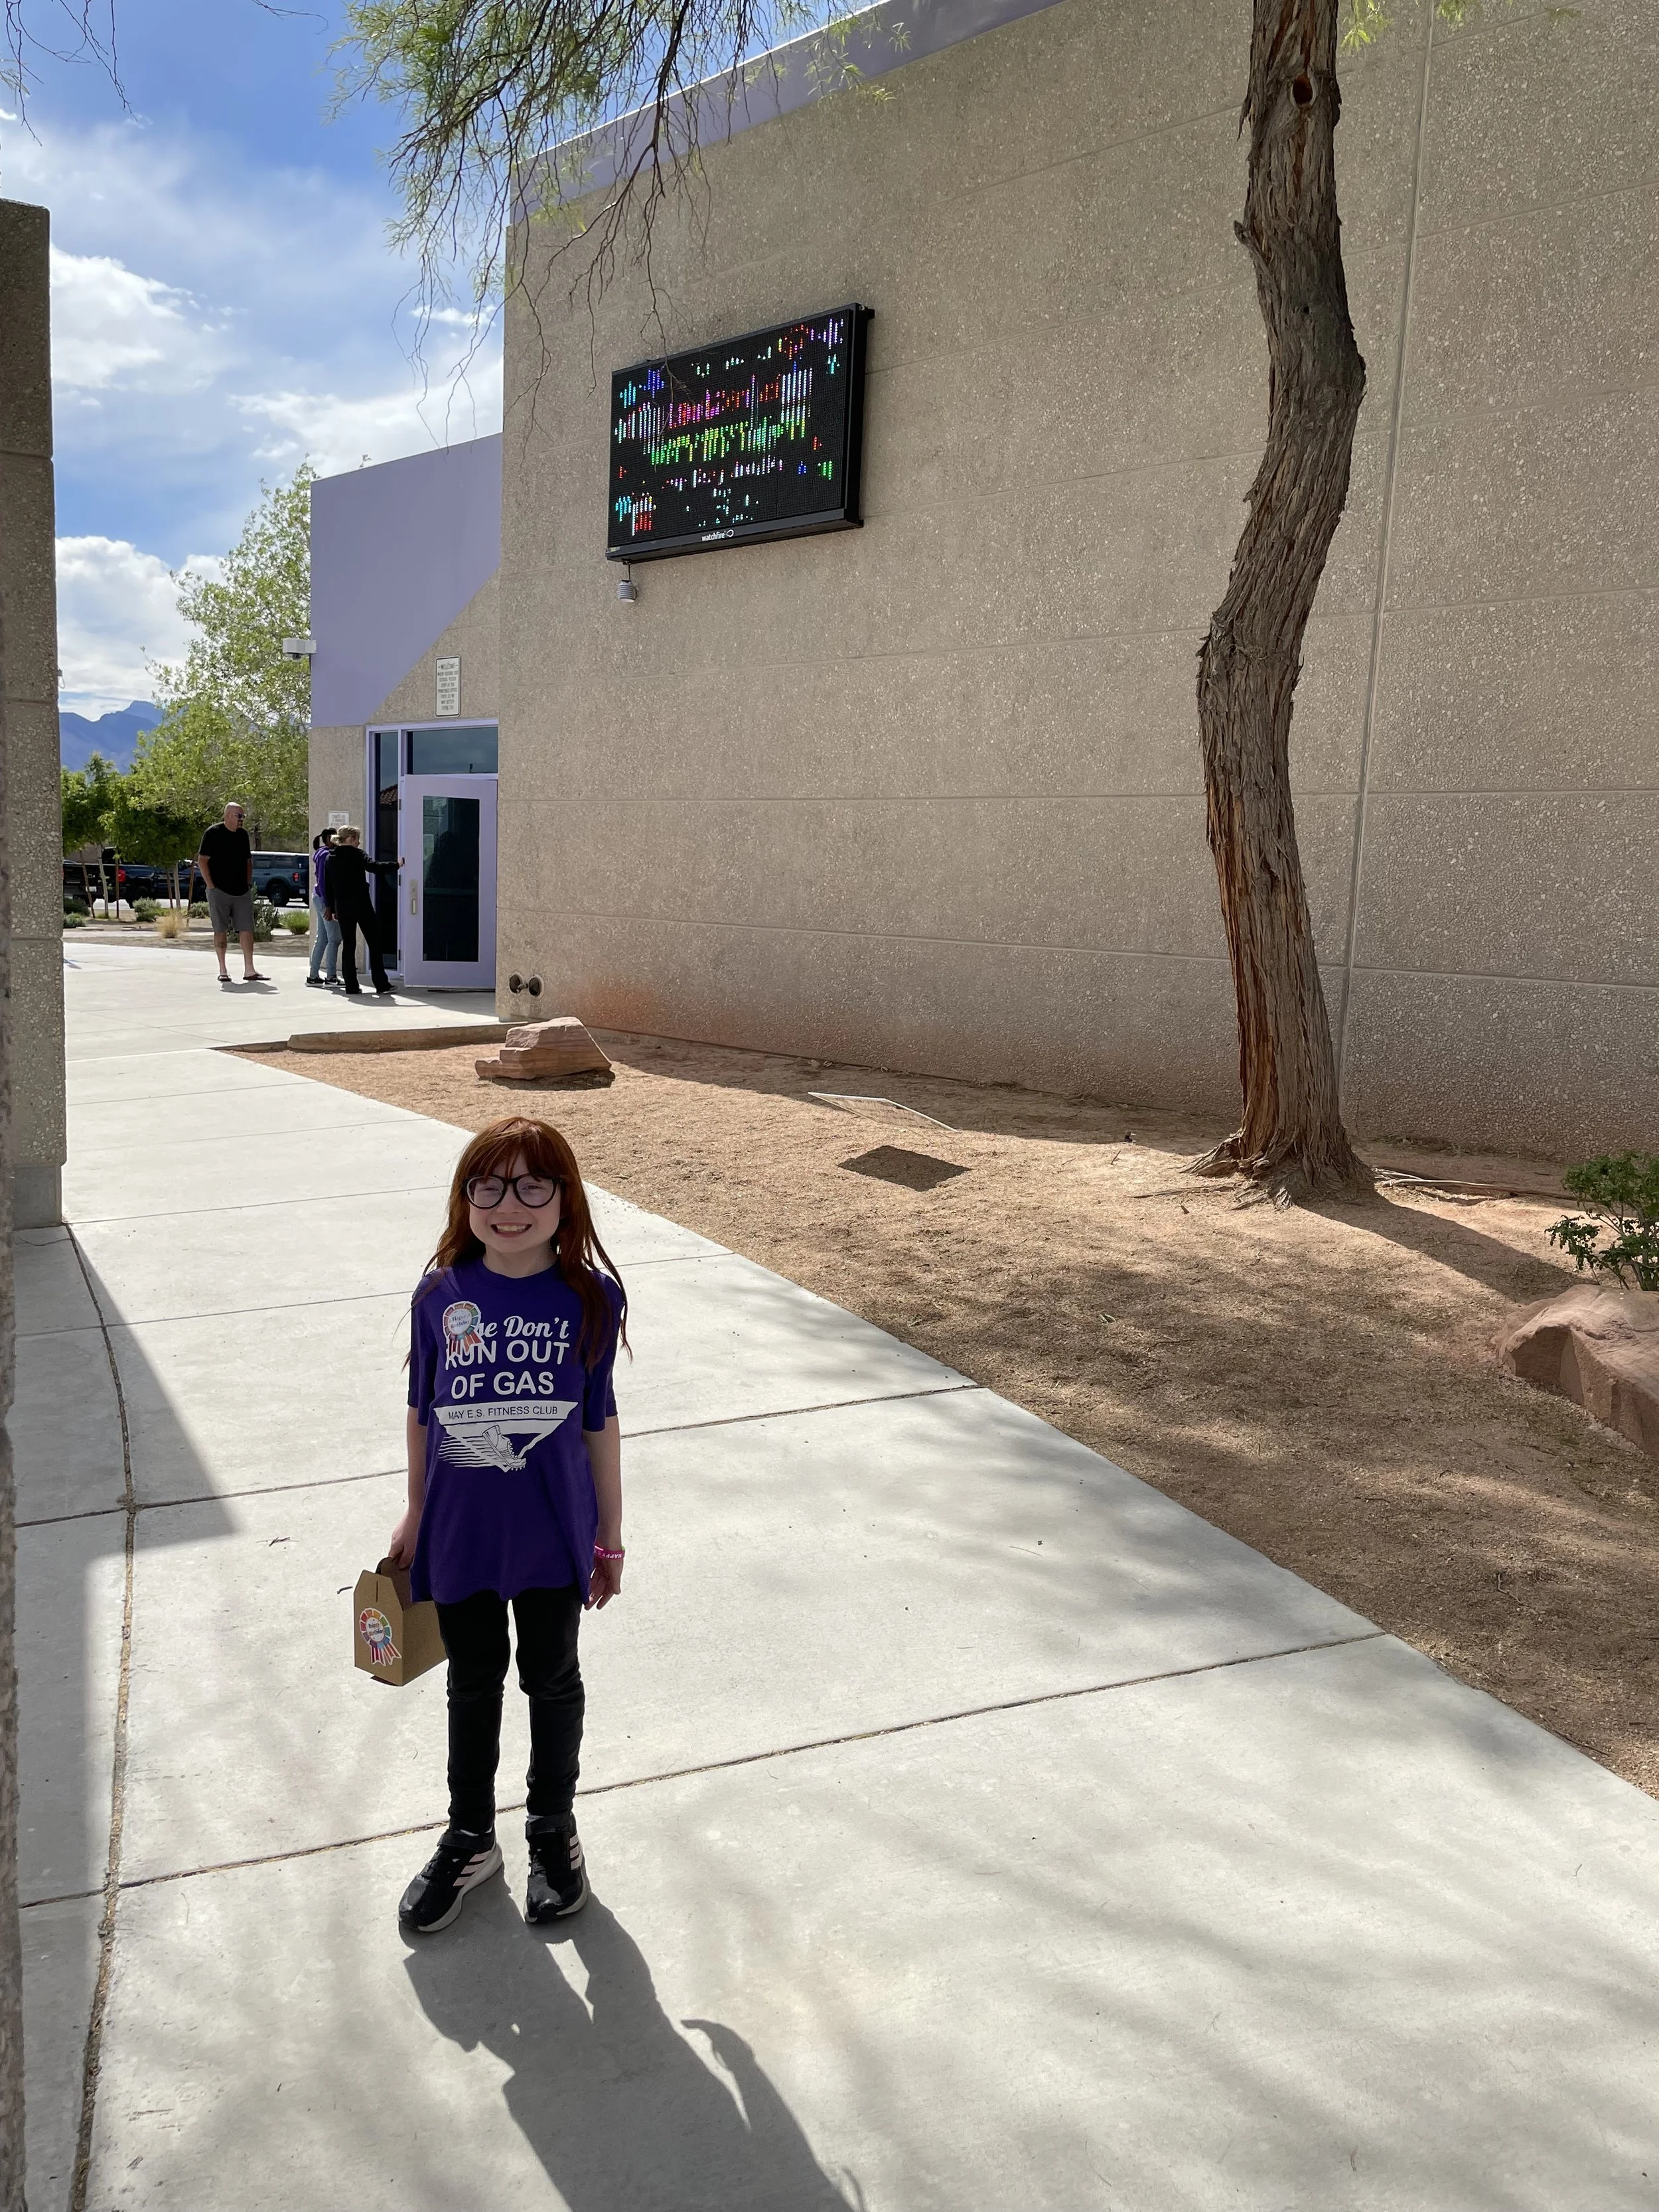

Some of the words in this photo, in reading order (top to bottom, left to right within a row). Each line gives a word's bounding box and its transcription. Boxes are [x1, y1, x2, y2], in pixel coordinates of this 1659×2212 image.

[701, 532, 725, 542] watchfire
[504, 1316, 569, 1339] Don't
[506, 1339, 570, 1365] OUT
[451, 1373, 486, 1400] OF
[493, 1370, 554, 1395] GAS
[488, 1406, 530, 1417] FITNESS
[532, 1406, 558, 1415] CLUB
